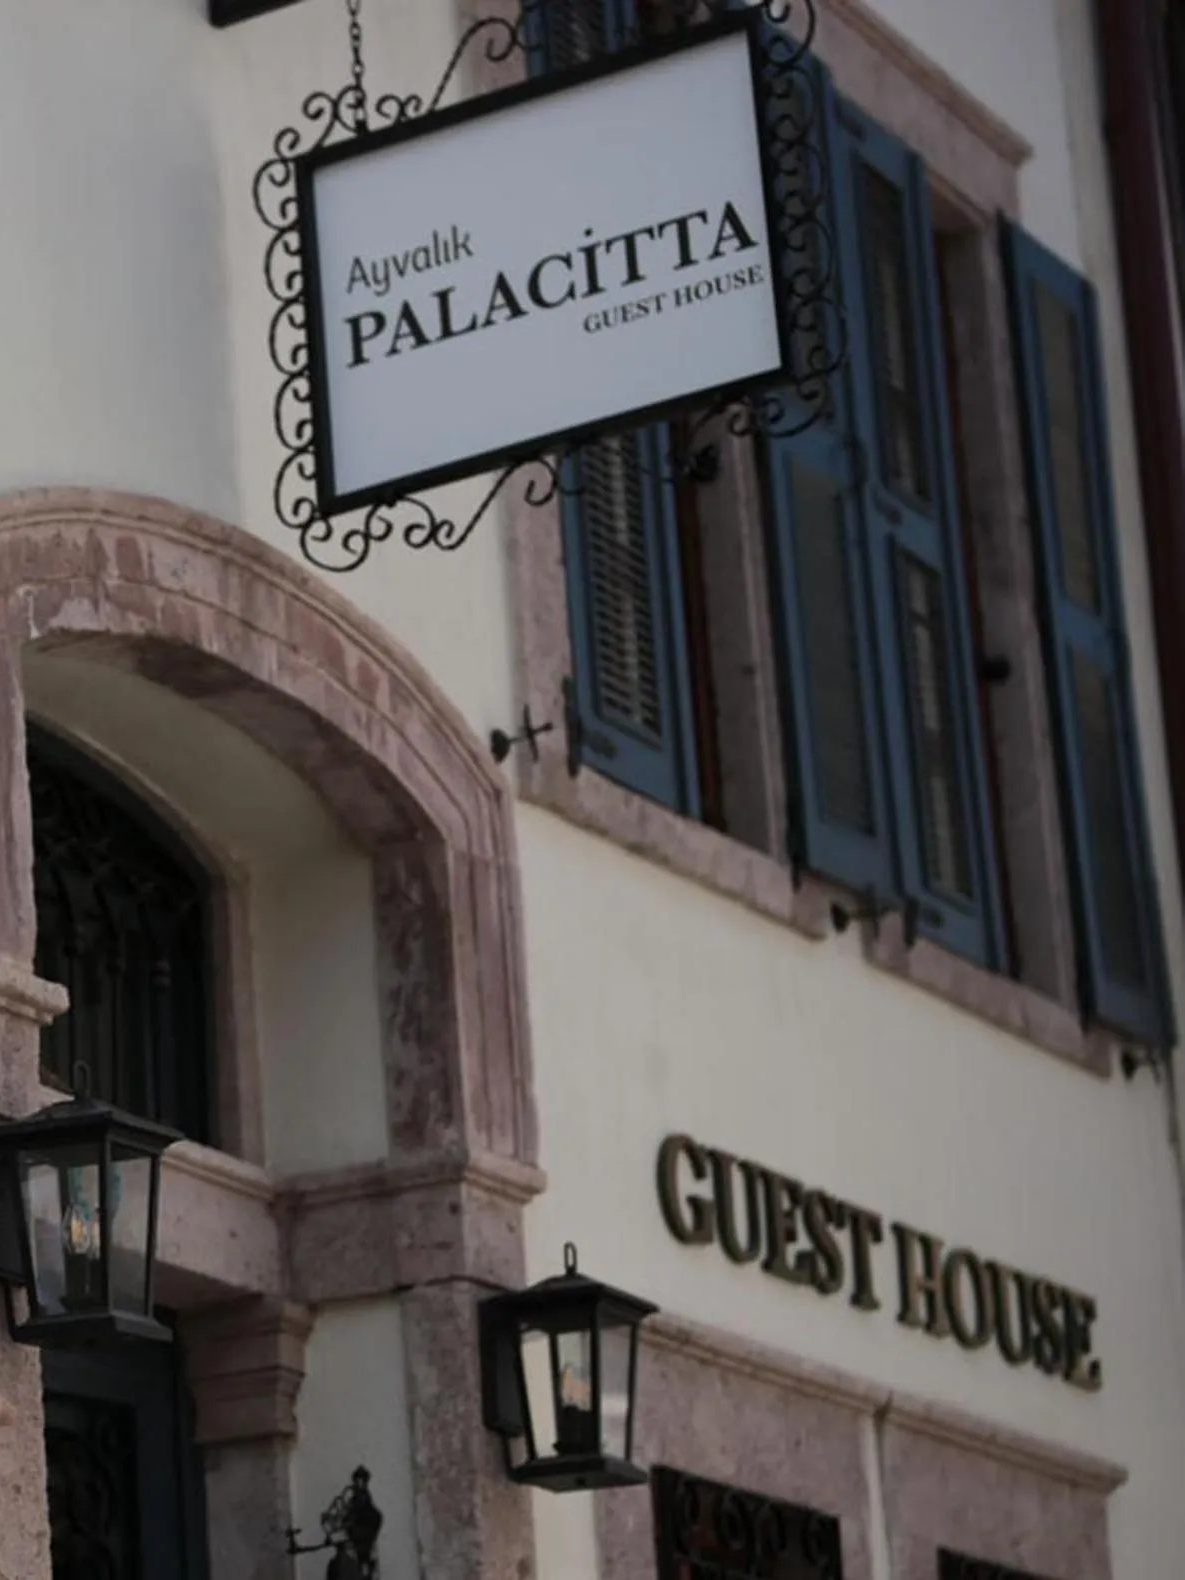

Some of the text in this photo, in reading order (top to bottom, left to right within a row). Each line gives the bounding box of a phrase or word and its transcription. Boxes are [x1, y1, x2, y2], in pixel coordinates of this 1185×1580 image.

[344, 201, 758, 368] PALACİTTA
[346, 225, 474, 296] Ayvalık
[583, 264, 763, 334] GUEST HOUSE
[656, 1134, 1102, 1392] GUEST HOUSE
